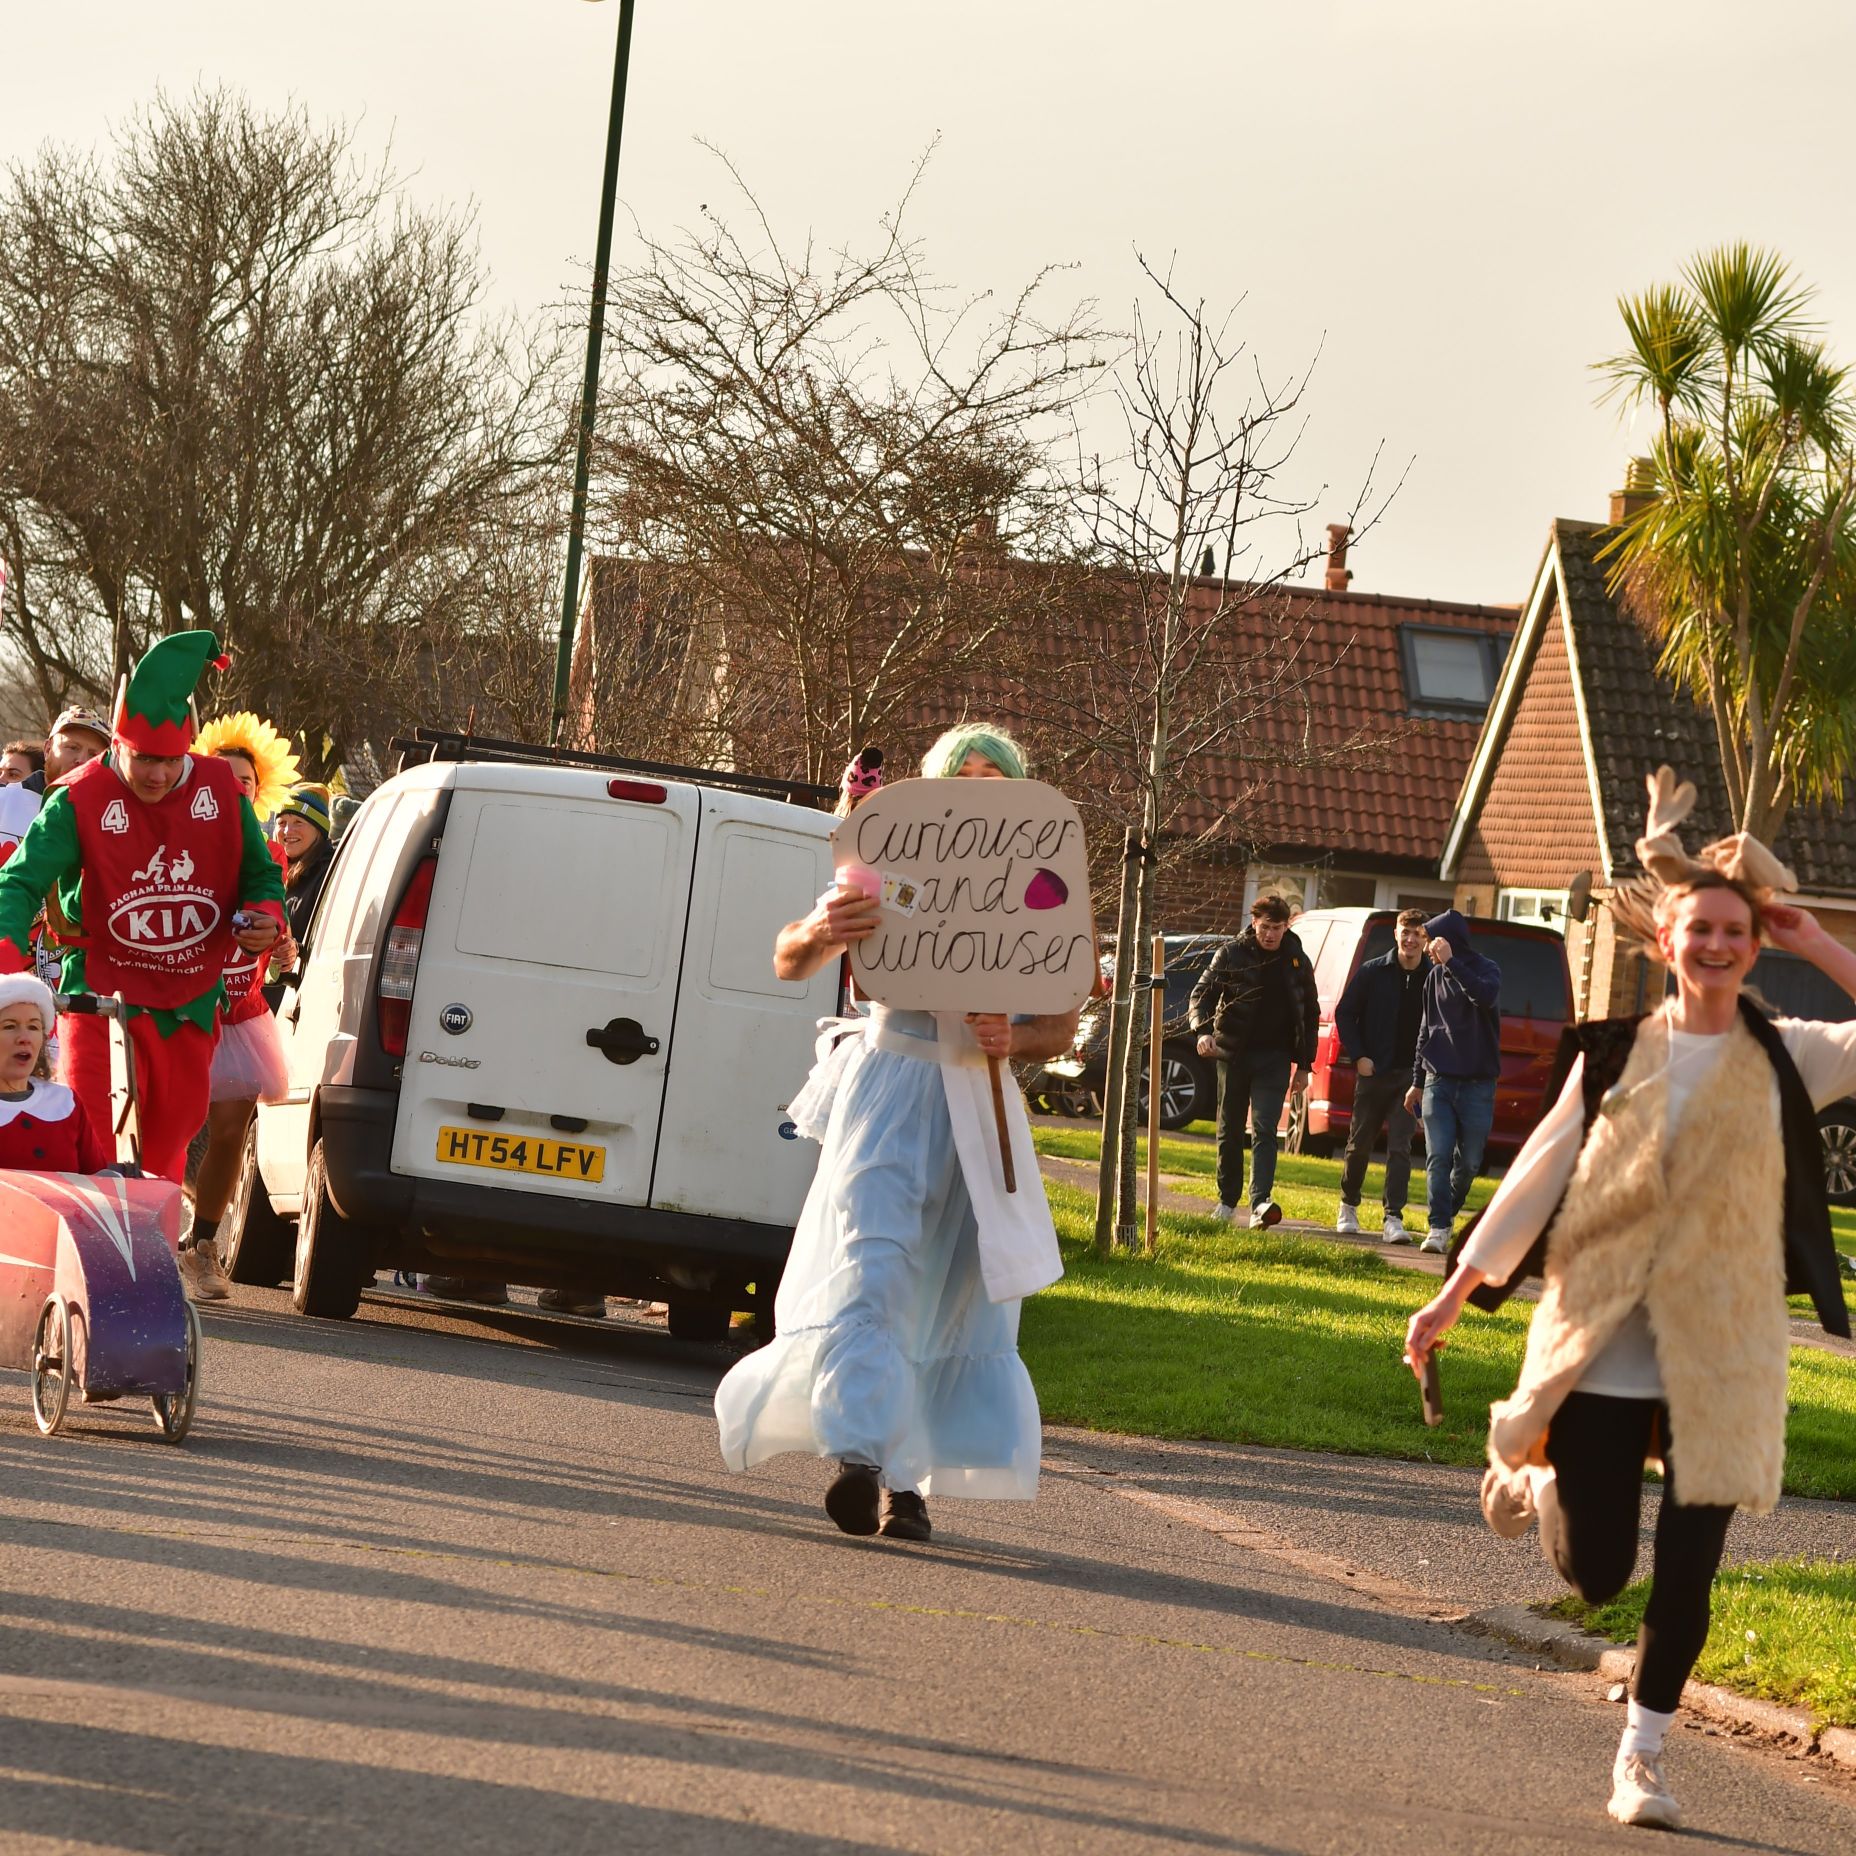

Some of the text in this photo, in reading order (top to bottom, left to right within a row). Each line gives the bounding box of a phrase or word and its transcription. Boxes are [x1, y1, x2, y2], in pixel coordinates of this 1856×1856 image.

[101, 799, 129, 834] 4
[190, 786, 219, 821] 4
[857, 808, 1078, 865] Curiouser
[109, 884, 215, 910] PAGHAM PRAM RACE
[919, 857, 1020, 914] and
[127, 904, 206, 940] KIA
[446, 1013, 467, 1025] FIAT
[450, 1131, 595, 1176] HT54 LFV
